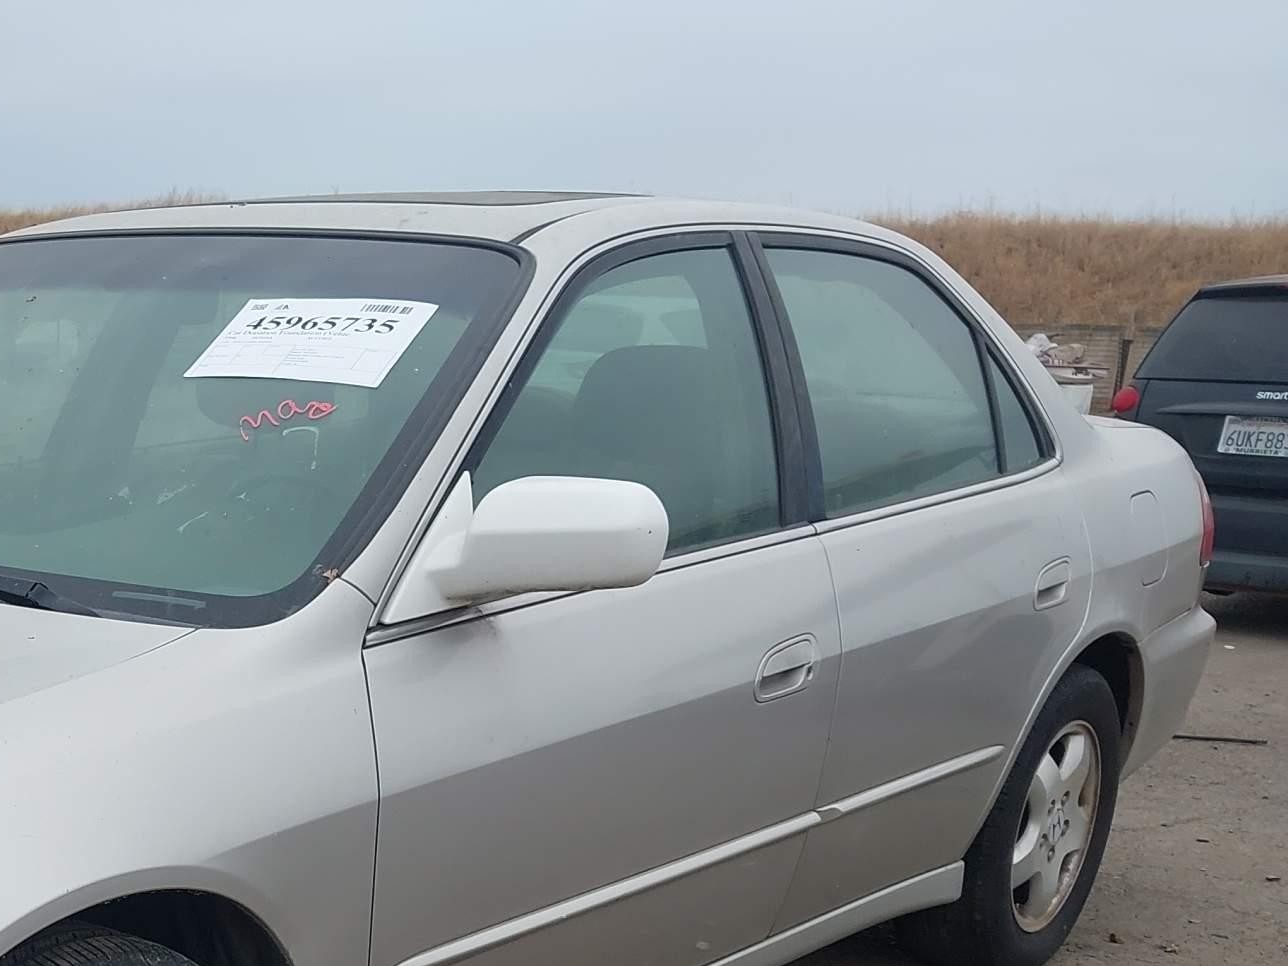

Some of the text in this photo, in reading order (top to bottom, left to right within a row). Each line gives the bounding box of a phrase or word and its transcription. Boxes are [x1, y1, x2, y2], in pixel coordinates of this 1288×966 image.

[246, 315, 400, 335] 45965735
[1255, 391, 1288, 400] smart
[1225, 430, 1288, 449] 6UKF88
